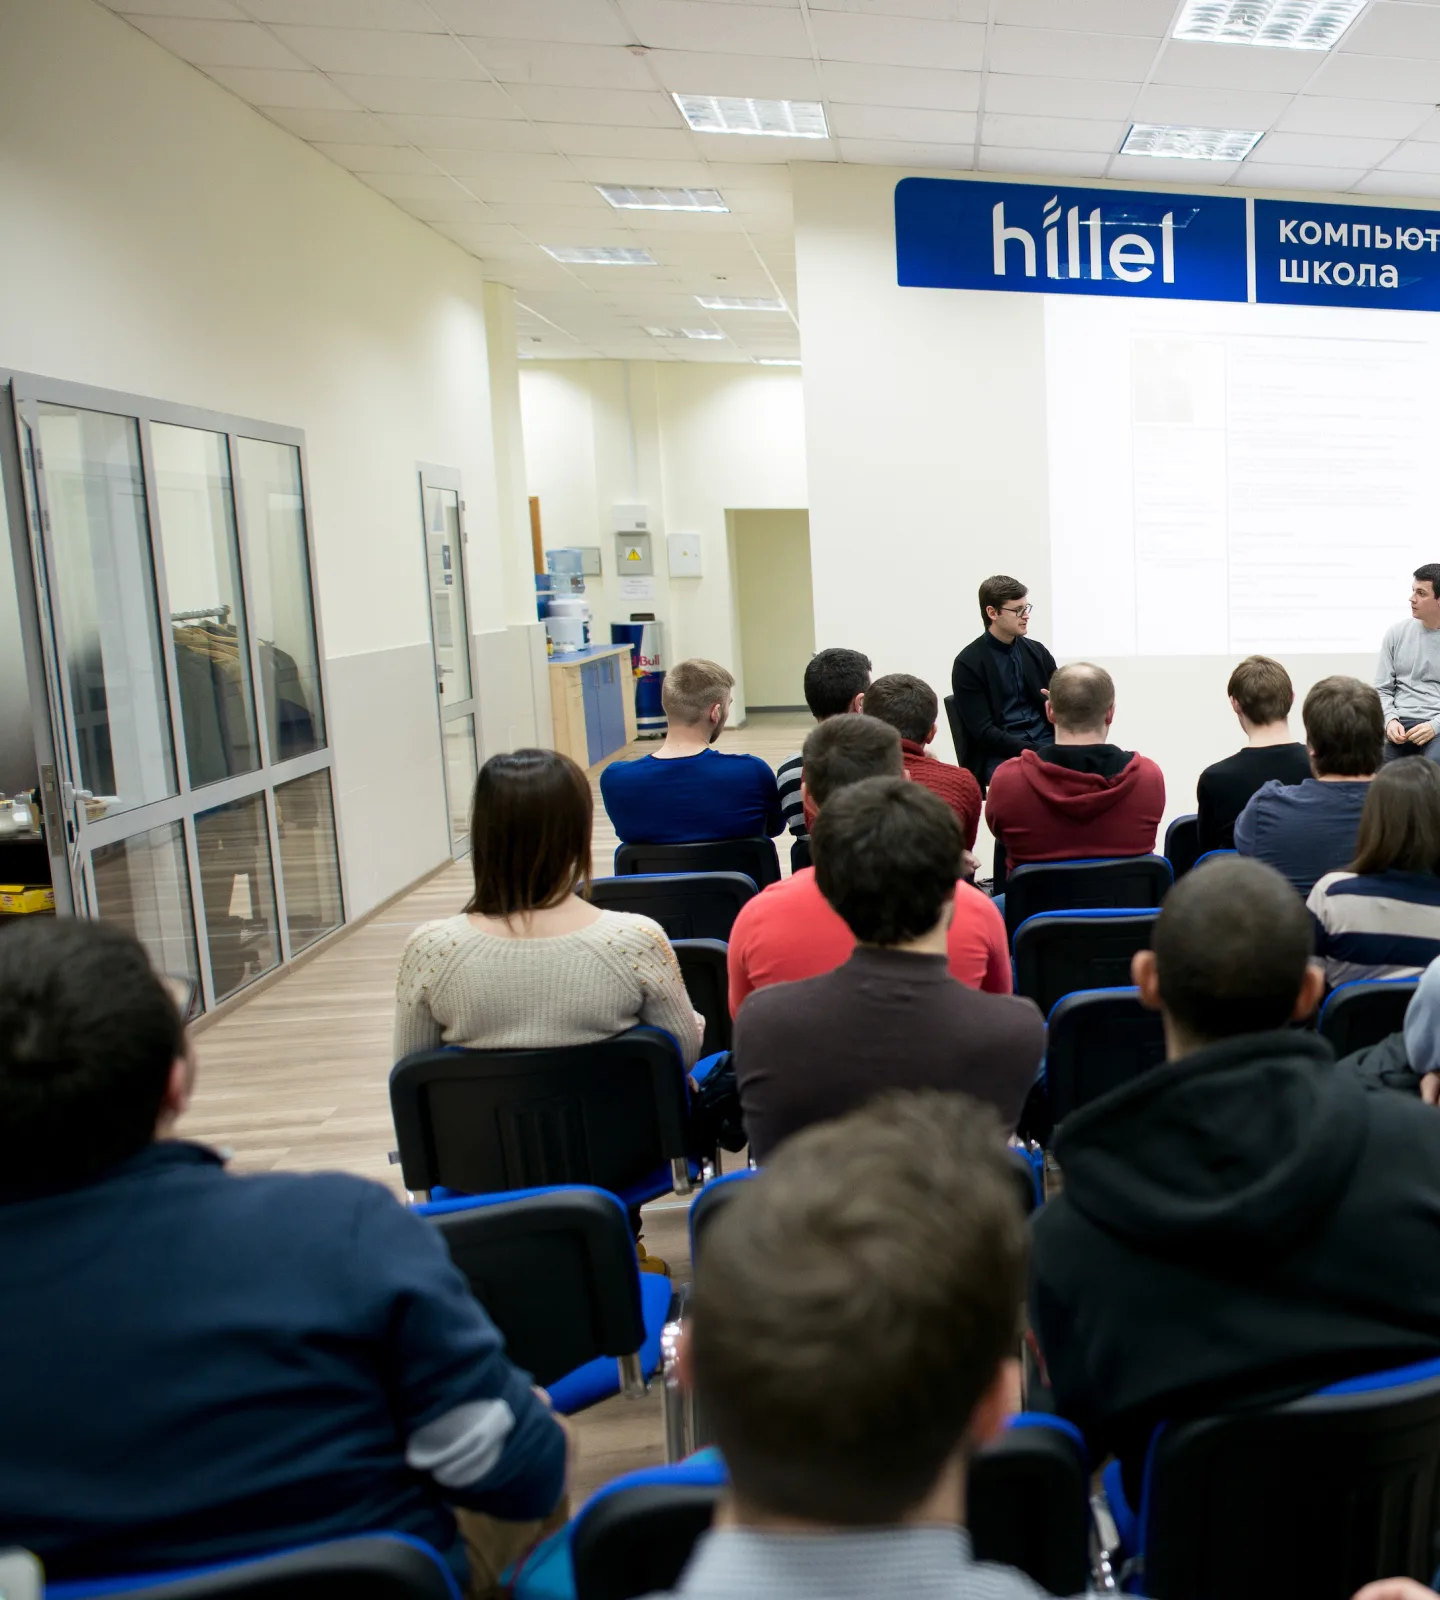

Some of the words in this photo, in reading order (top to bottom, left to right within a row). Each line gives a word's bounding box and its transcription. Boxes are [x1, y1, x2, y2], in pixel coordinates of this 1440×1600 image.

[992, 195, 1175, 284] hillel
[1279, 257, 1400, 289] школа
[640, 655, 660, 666] Bull
